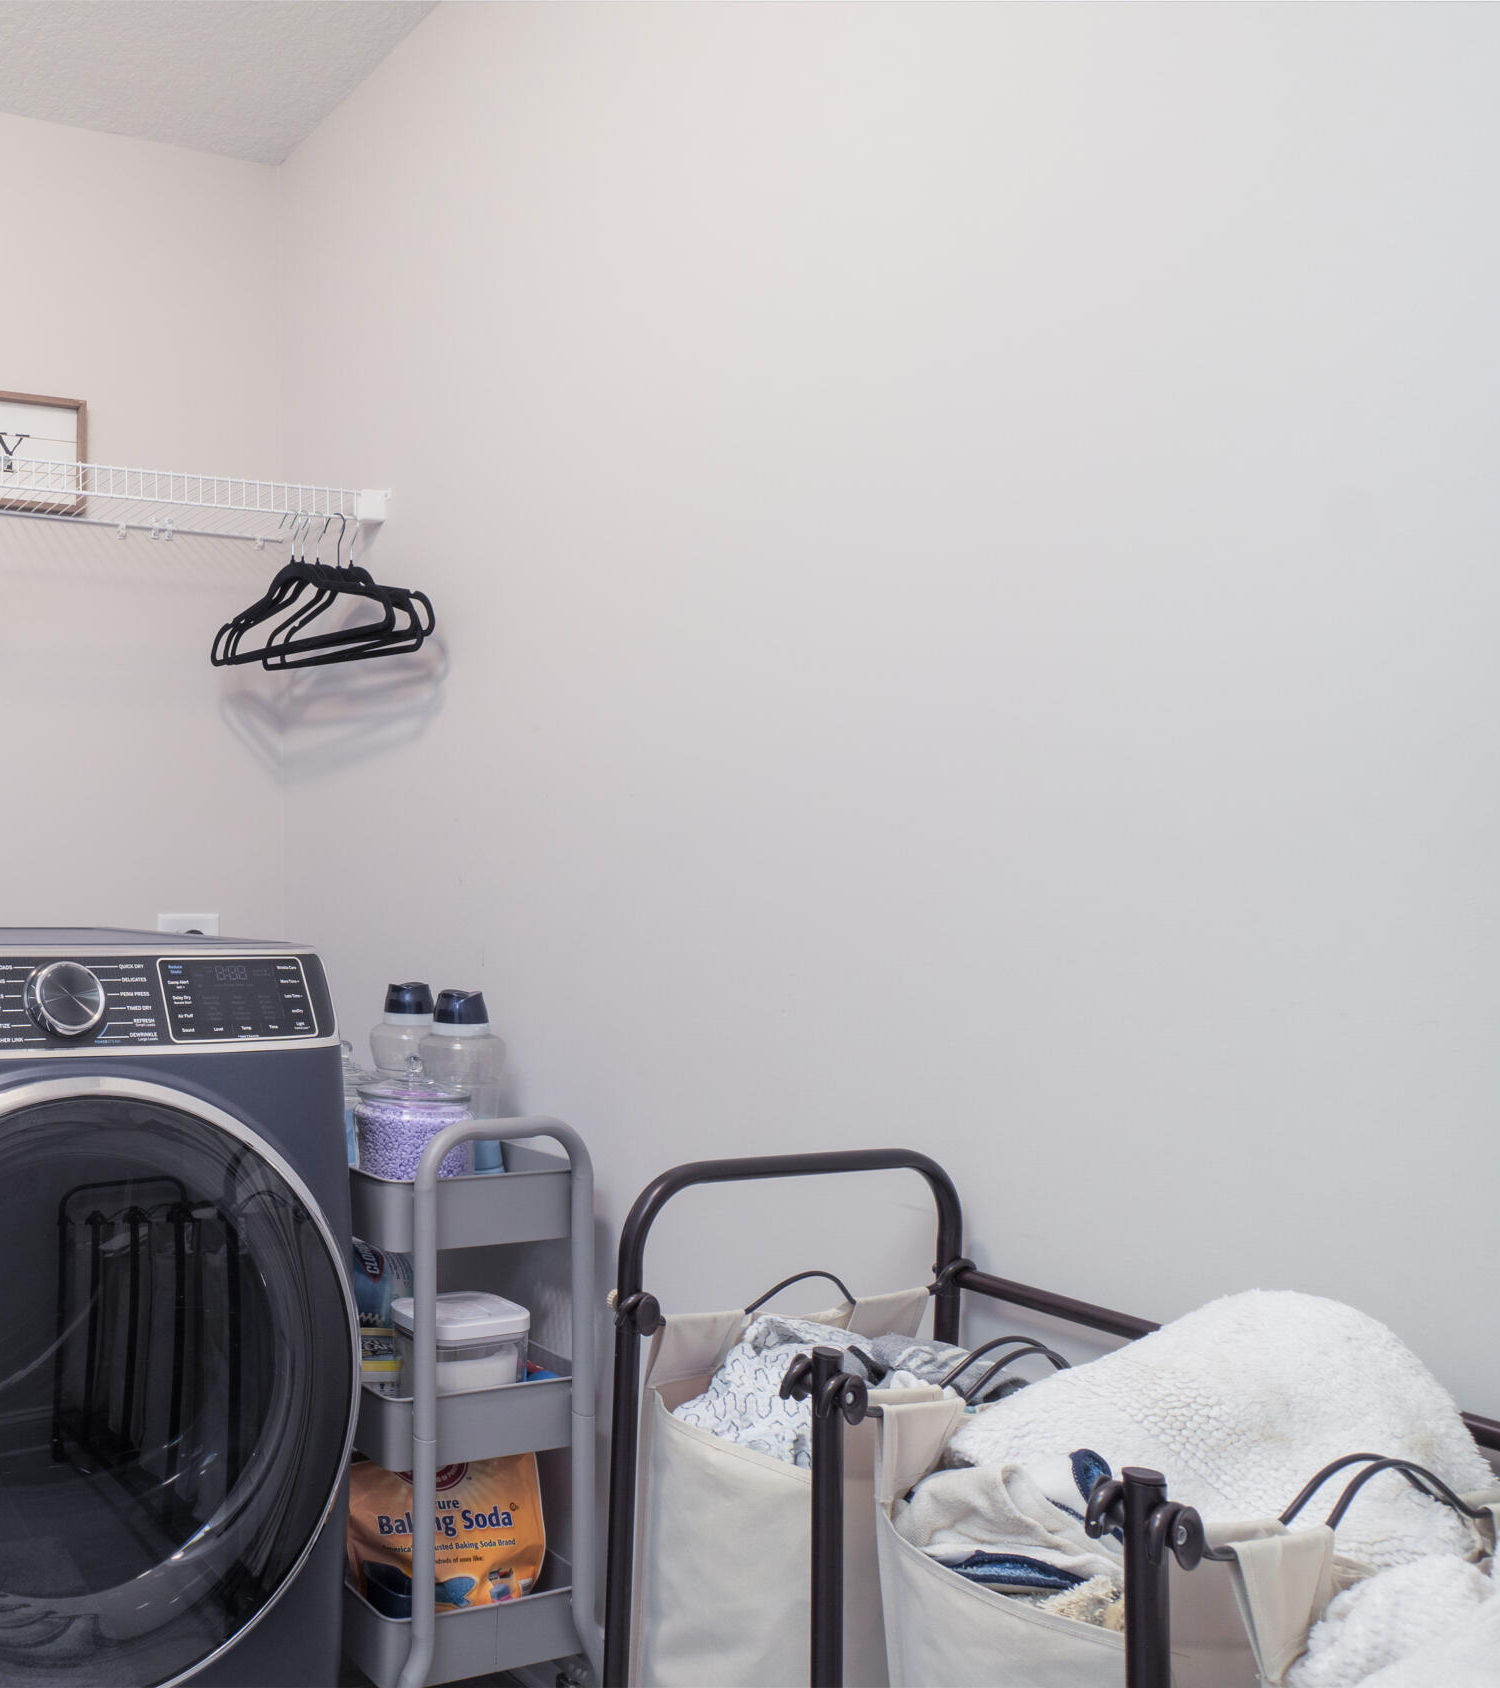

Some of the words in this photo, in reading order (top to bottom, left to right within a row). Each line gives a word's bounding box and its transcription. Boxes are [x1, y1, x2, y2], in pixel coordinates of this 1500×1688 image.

[436, 1499, 460, 1510] ure
[377, 1512, 456, 1537] Bang
[461, 1505, 513, 1530] Soda
[435, 1542, 453, 1551] usted
[455, 1541, 479, 1551] Baking
[480, 1539, 497, 1548] Soda
[498, 1538, 516, 1546] Brand
